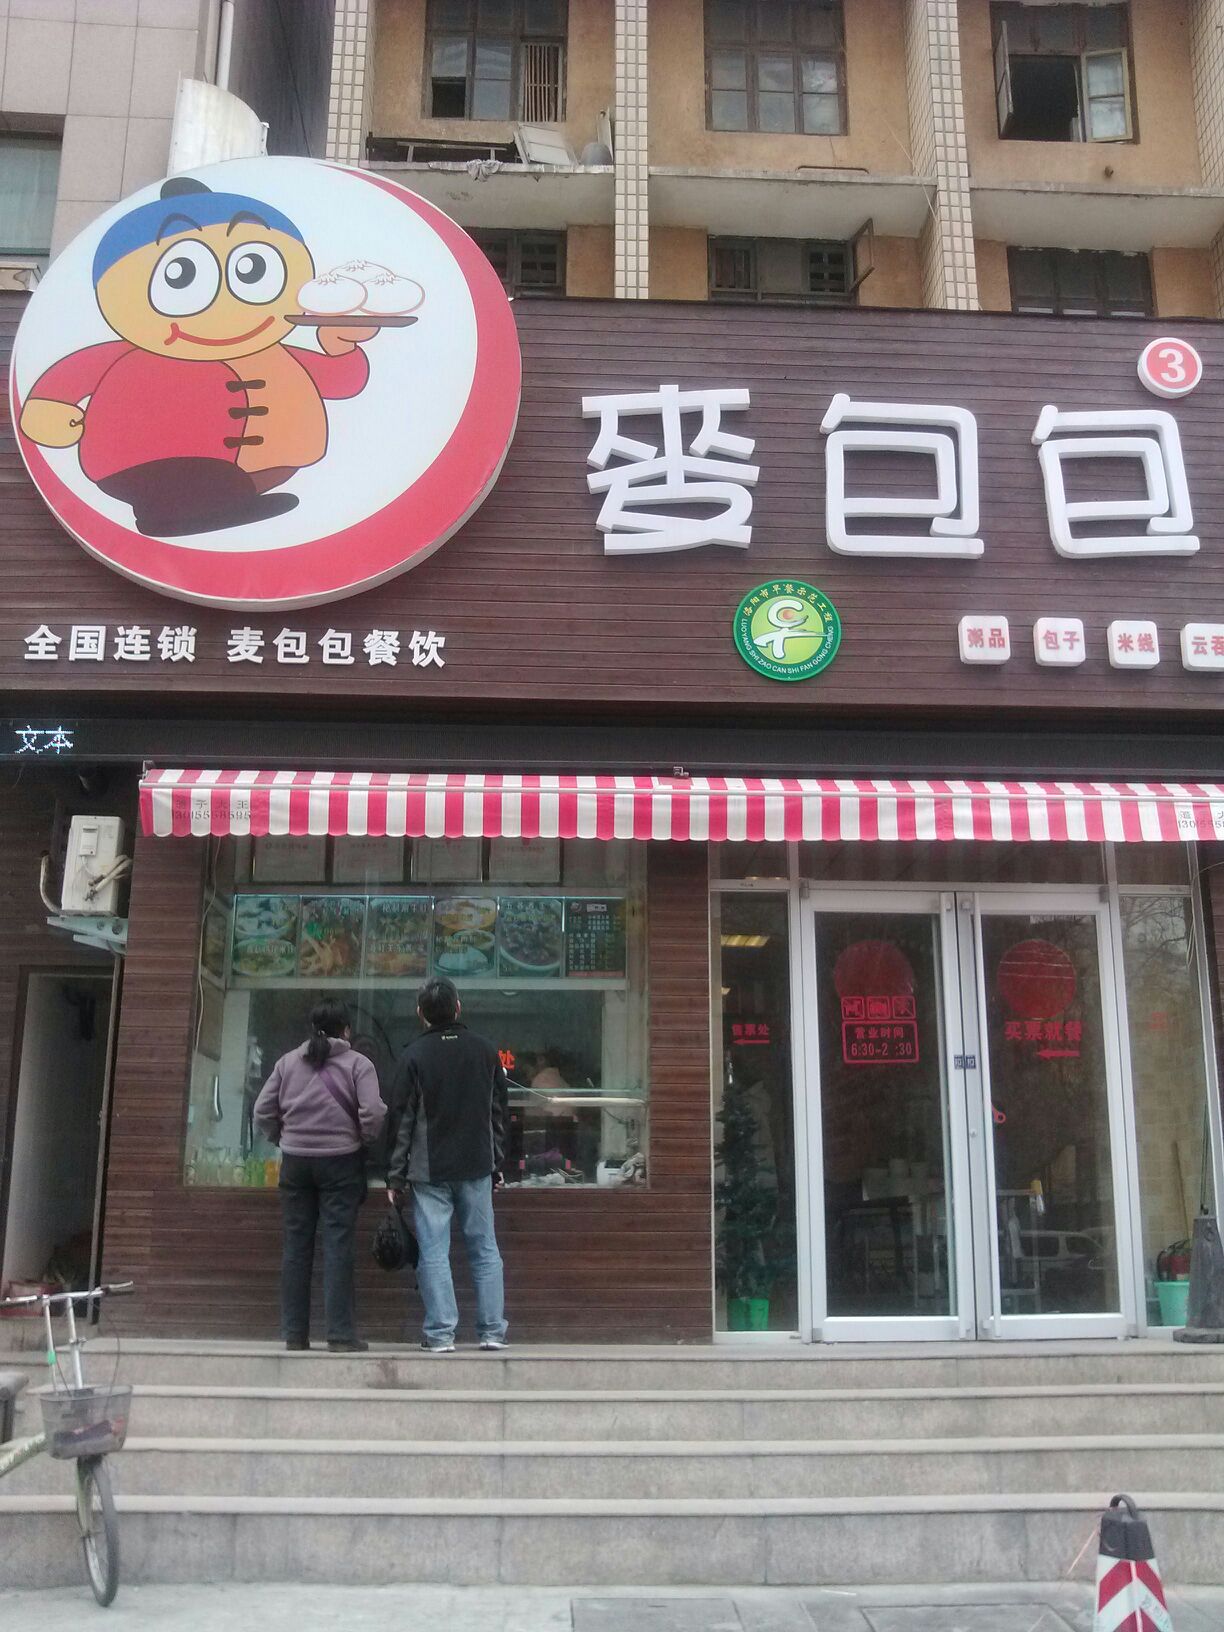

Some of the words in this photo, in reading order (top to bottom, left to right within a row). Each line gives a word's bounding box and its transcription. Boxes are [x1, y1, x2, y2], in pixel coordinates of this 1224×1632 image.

[1159, 348, 1186, 382] 3
[24, 624, 196, 662] 全国连锁
[226, 626, 447, 668] 麦包包餐饮
[741, 618, 751, 650] LUOYANG
[749, 649, 760, 661] SHI
[758, 659, 772, 670] ZAO
[772, 665, 787, 674] CAN
[787, 666, 800, 674] SHI
[800, 662, 813, 672] FAN
[812, 649, 828, 666] GONG
[826, 626, 834, 649] CHENG
[966, 628, 1006, 649] 粥品
[1042, 630, 1080, 650] 包子
[1117, 633, 1155, 653] 米线
[1191, 636, 1224, 656] 云吞
[855, 1026, 904, 1039] 营业时间
